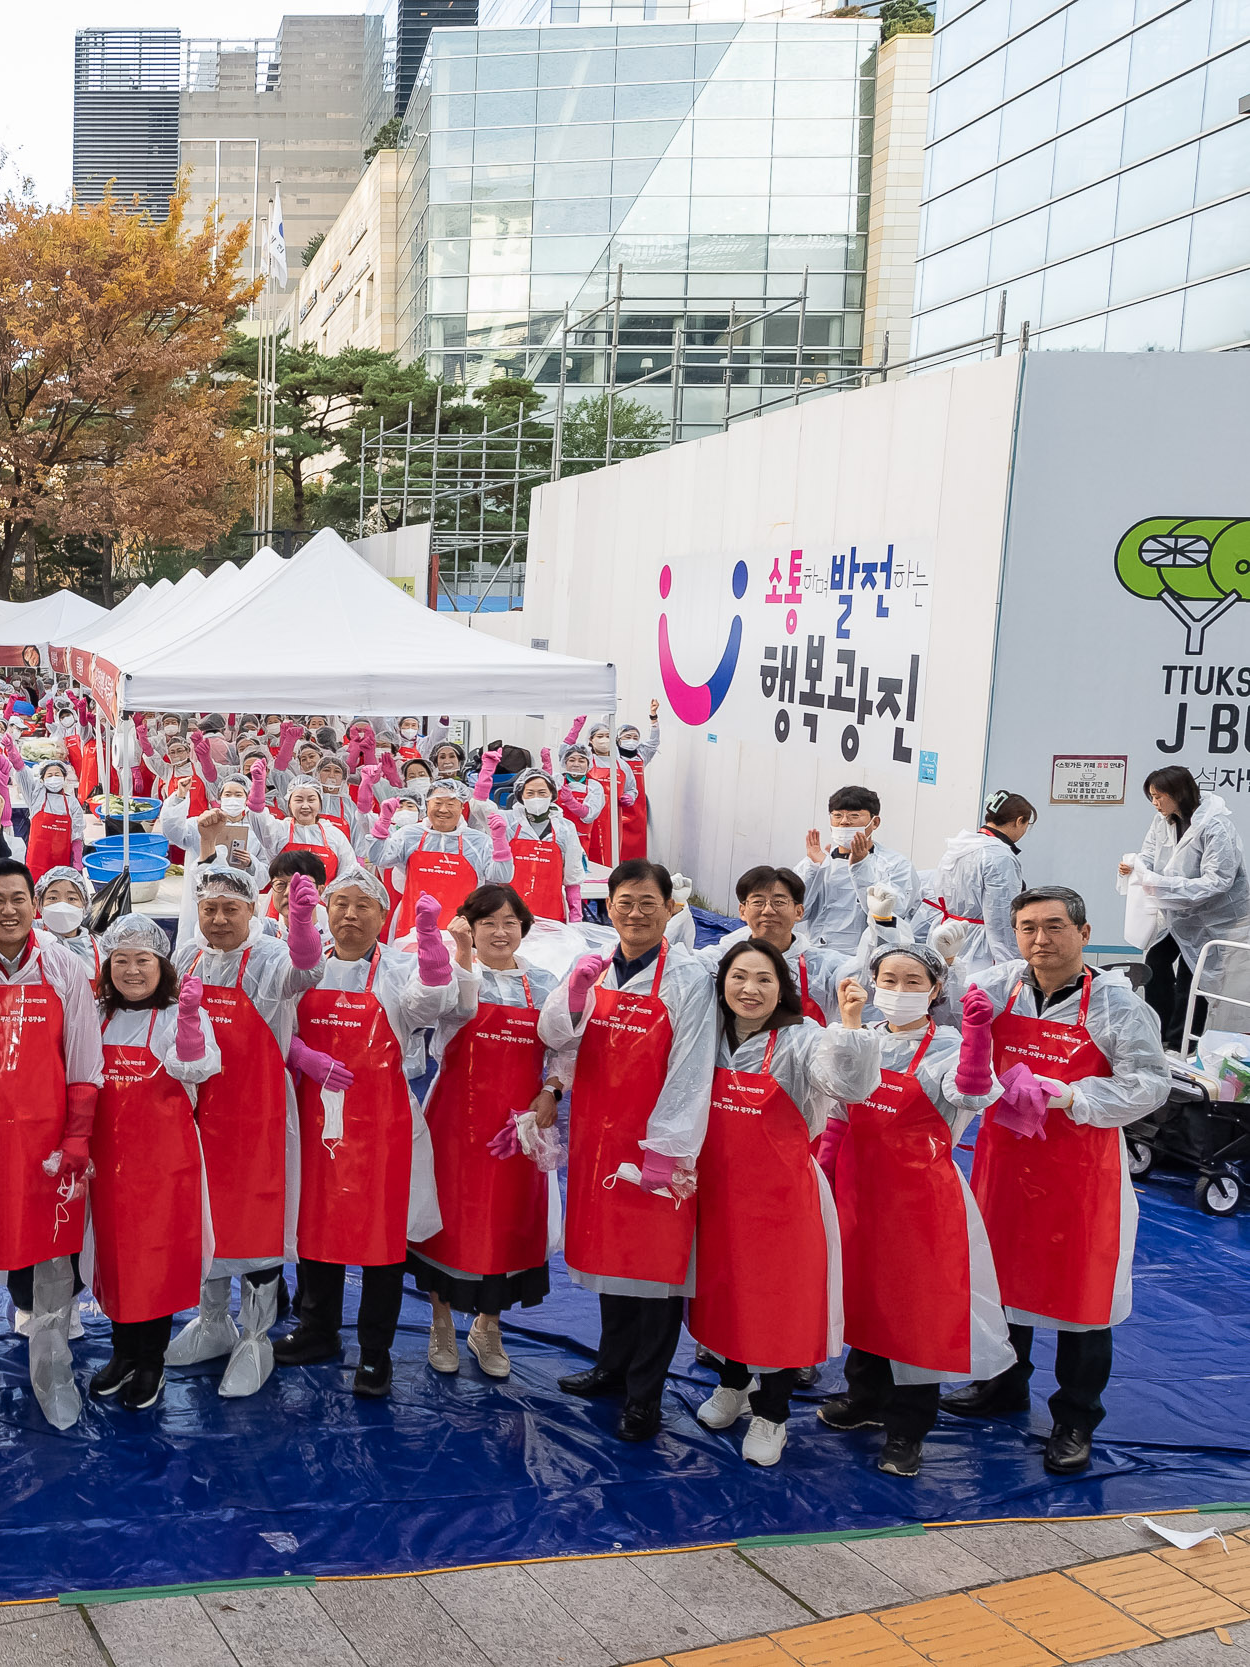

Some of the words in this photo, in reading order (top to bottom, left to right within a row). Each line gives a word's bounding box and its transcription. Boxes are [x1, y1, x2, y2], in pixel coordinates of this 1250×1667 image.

[765, 550, 830, 634] 소통하며
[830, 544, 928, 639] 발전하는
[760, 634, 920, 764] 행복광진
